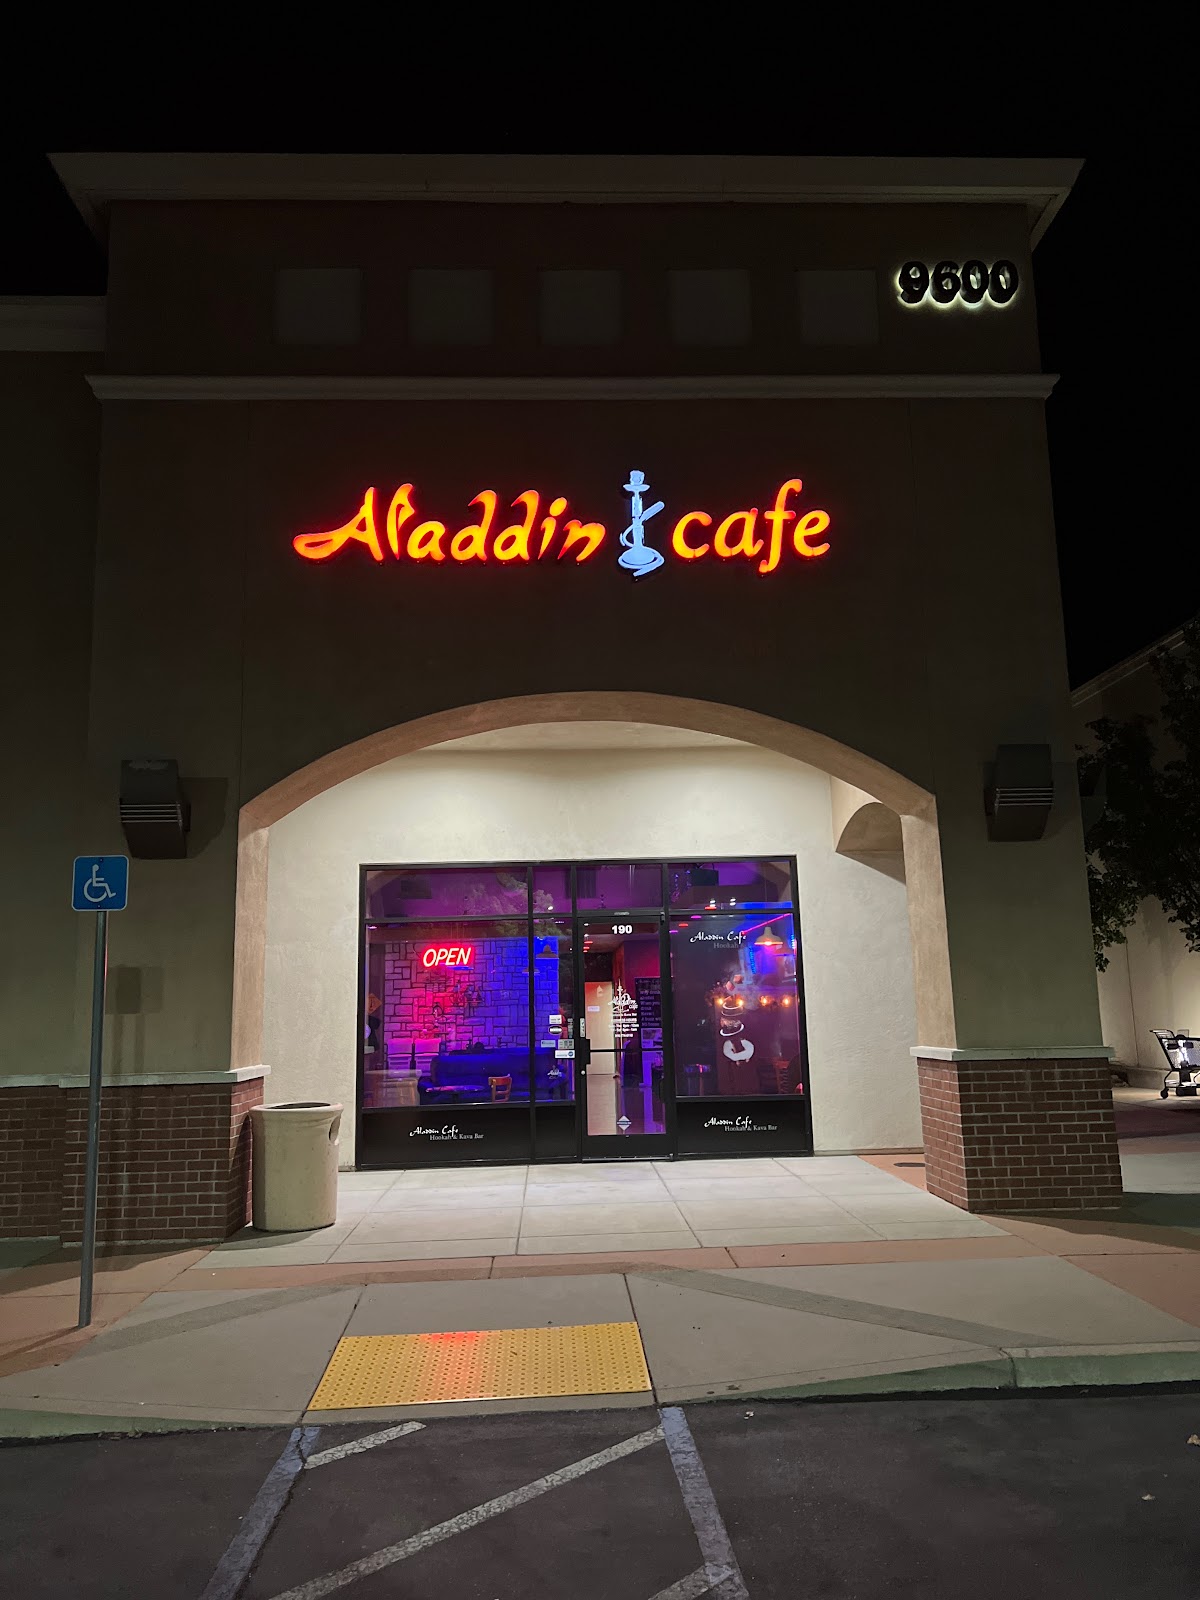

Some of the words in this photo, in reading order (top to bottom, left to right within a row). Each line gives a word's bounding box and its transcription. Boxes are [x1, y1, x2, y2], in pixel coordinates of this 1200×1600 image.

[898, 260, 1019, 304] 9600
[293, 483, 606, 562] Aladdin
[671, 478, 832, 575] cafe
[611, 924, 633, 935] 190
[727, 930, 747, 945] Cafe
[422, 947, 472, 967] OPEN
[735, 1116, 752, 1128] Cafe
[429, 1133, 452, 1141] Hookah
[441, 1125, 459, 1137] Cafe
